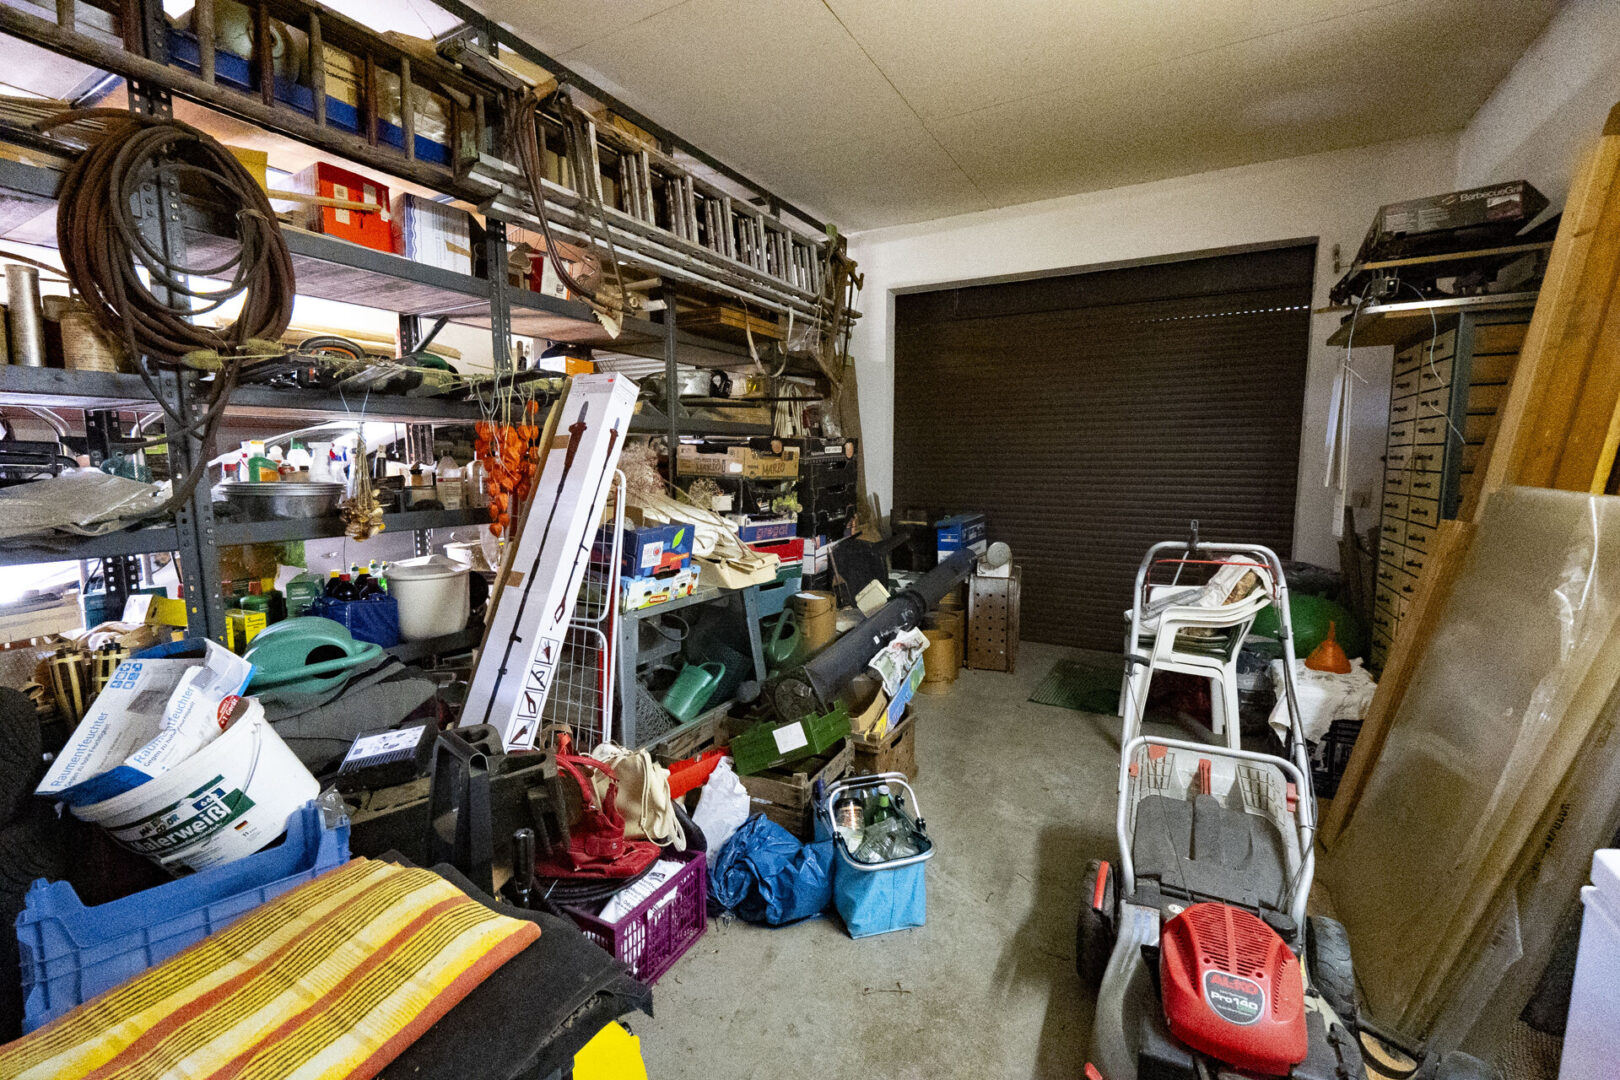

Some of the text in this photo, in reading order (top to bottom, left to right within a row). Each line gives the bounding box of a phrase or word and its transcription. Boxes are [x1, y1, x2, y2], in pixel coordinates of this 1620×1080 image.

[762, 462, 786, 476] MARIO
[50, 711, 109, 787] Raumentfeuchter
[131, 801, 228, 852] Malerweiß
